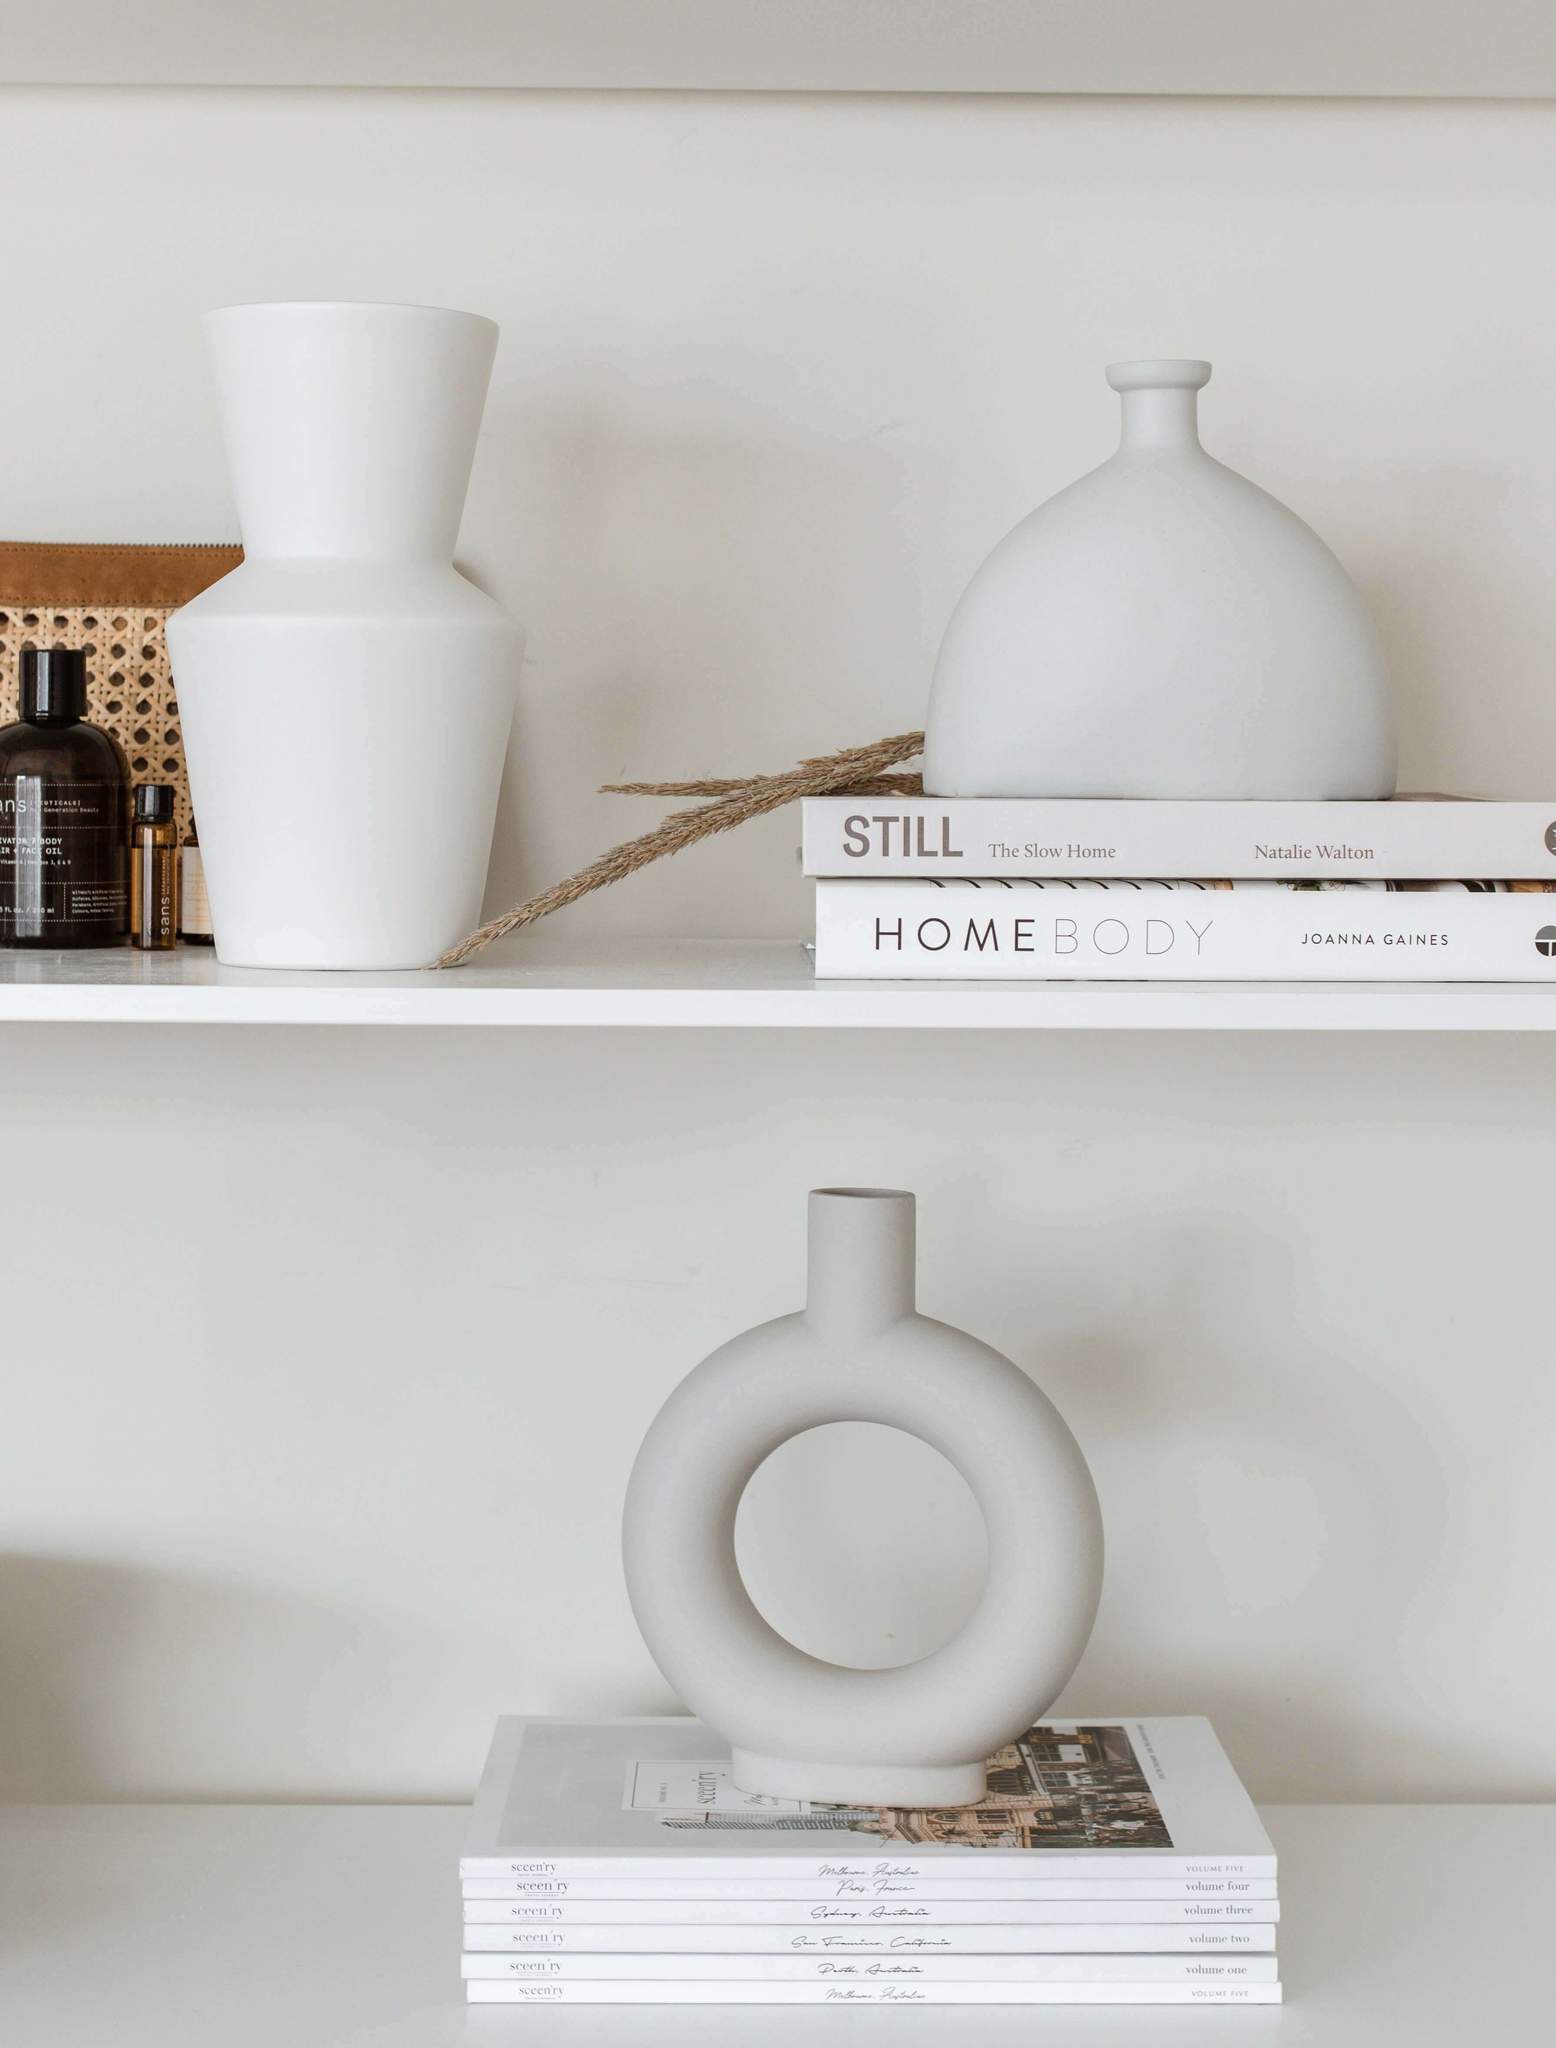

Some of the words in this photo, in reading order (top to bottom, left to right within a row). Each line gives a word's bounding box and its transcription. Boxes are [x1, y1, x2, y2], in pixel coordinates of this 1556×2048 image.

[0, 799, 26, 813] ns
[842, 814, 964, 858] STILL
[988, 843, 1020, 859] The
[1023, 843, 1063, 859] Slow
[1067, 844, 1116, 859] Home
[45, 847, 62, 855] OIL
[1254, 844, 1312, 860] Natalie
[1316, 844, 1375, 860] Walton
[161, 896, 170, 935] sans
[1301, 933, 1375, 946] JOANNA
[1383, 933, 1449, 946] GAINES
[1185, 1865, 1222, 1873] VOLUME
[1225, 1865, 1244, 1873] FIVE
[873, 1878, 915, 1896] France
[1185, 1881, 1225, 1891] volume
[1227, 1881, 1250, 1891] four
[1184, 1904, 1223, 1915] volume
[1225, 1905, 1254, 1914] three
[1188, 1933, 1228, 1943] volume
[1230, 1935, 1250, 1943] two
[1185, 1964, 1225, 1974] volume
[1227, 1967, 1248, 1975] one
[1191, 1990, 1226, 1998] VOLUME
